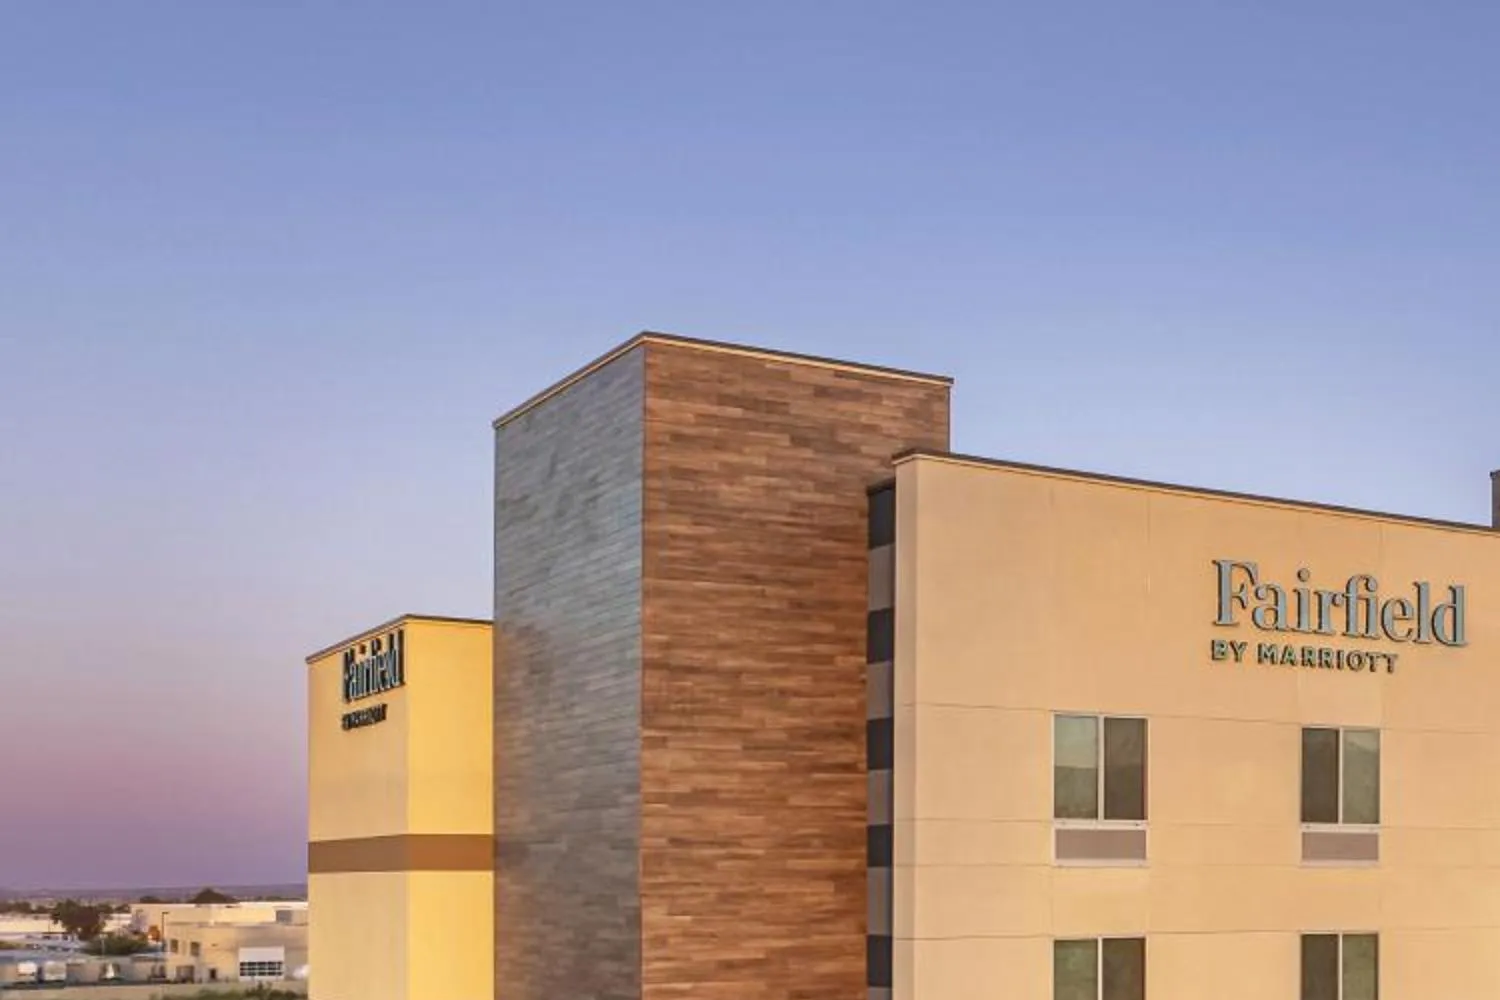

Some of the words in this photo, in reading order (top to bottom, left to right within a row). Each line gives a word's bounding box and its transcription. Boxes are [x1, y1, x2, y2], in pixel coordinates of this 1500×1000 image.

[1211, 558, 1468, 648] Fairfield
[1210, 639, 1248, 663] BY
[1256, 642, 1398, 674] MARRIOTT
